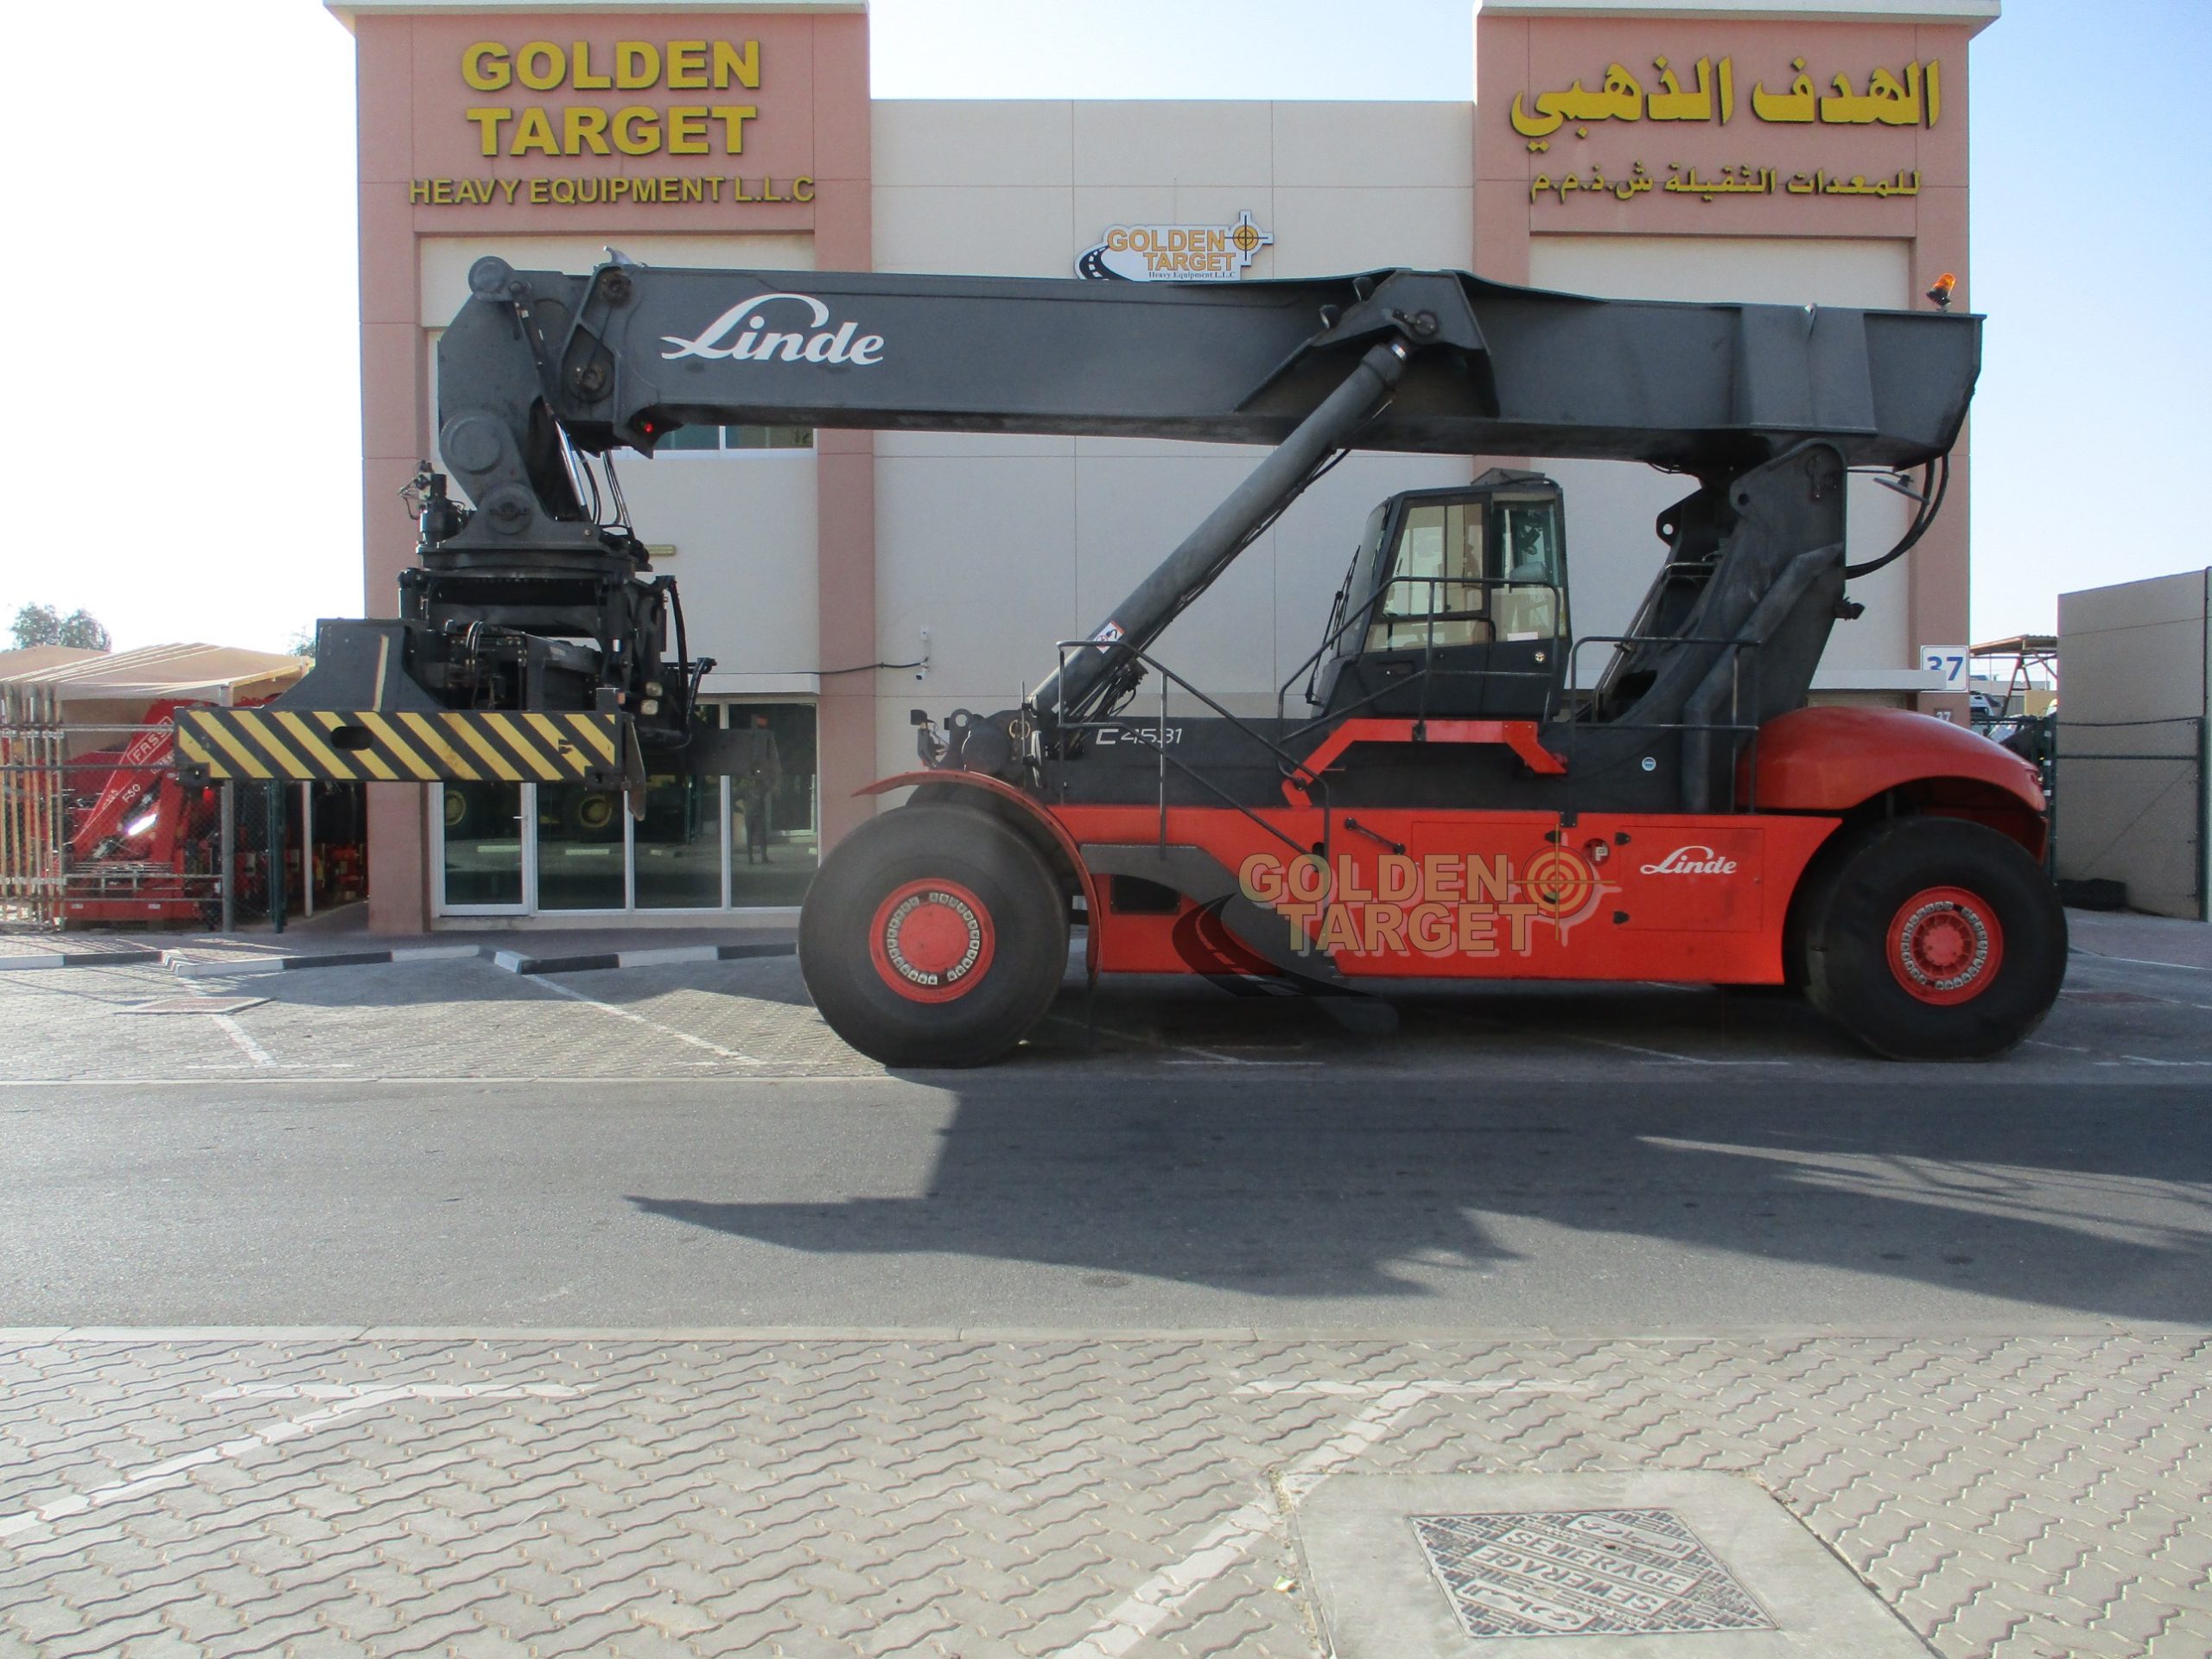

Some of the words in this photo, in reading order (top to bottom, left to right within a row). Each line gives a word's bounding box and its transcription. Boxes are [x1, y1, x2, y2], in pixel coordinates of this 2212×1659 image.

[461, 40, 760, 92] GOLDEN
[1510, 54, 1733, 153] الذهبي
[1752, 55, 1941, 130] الهدف
[466, 105, 758, 157] TARGET
[409, 178, 520, 206] HEAVY
[529, 175, 727, 206] EQUIPMENT
[734, 175, 817, 203] L.L.C
[1664, 162, 1777, 202] الثقيلة
[1785, 168, 1922, 200] للمعدات
[1107, 228, 1226, 252] GOLDEN
[1142, 251, 1236, 272] TARGET
[1173, 271, 1213, 280] Equipment
[659, 293, 885, 365] Linde
[1927, 656, 1964, 681] 37
[1640, 845, 1738, 874] Linde
[1473, 1548, 1658, 1611] SEWERAGE
[1507, 1530, 1688, 1592] SEWERAGE
